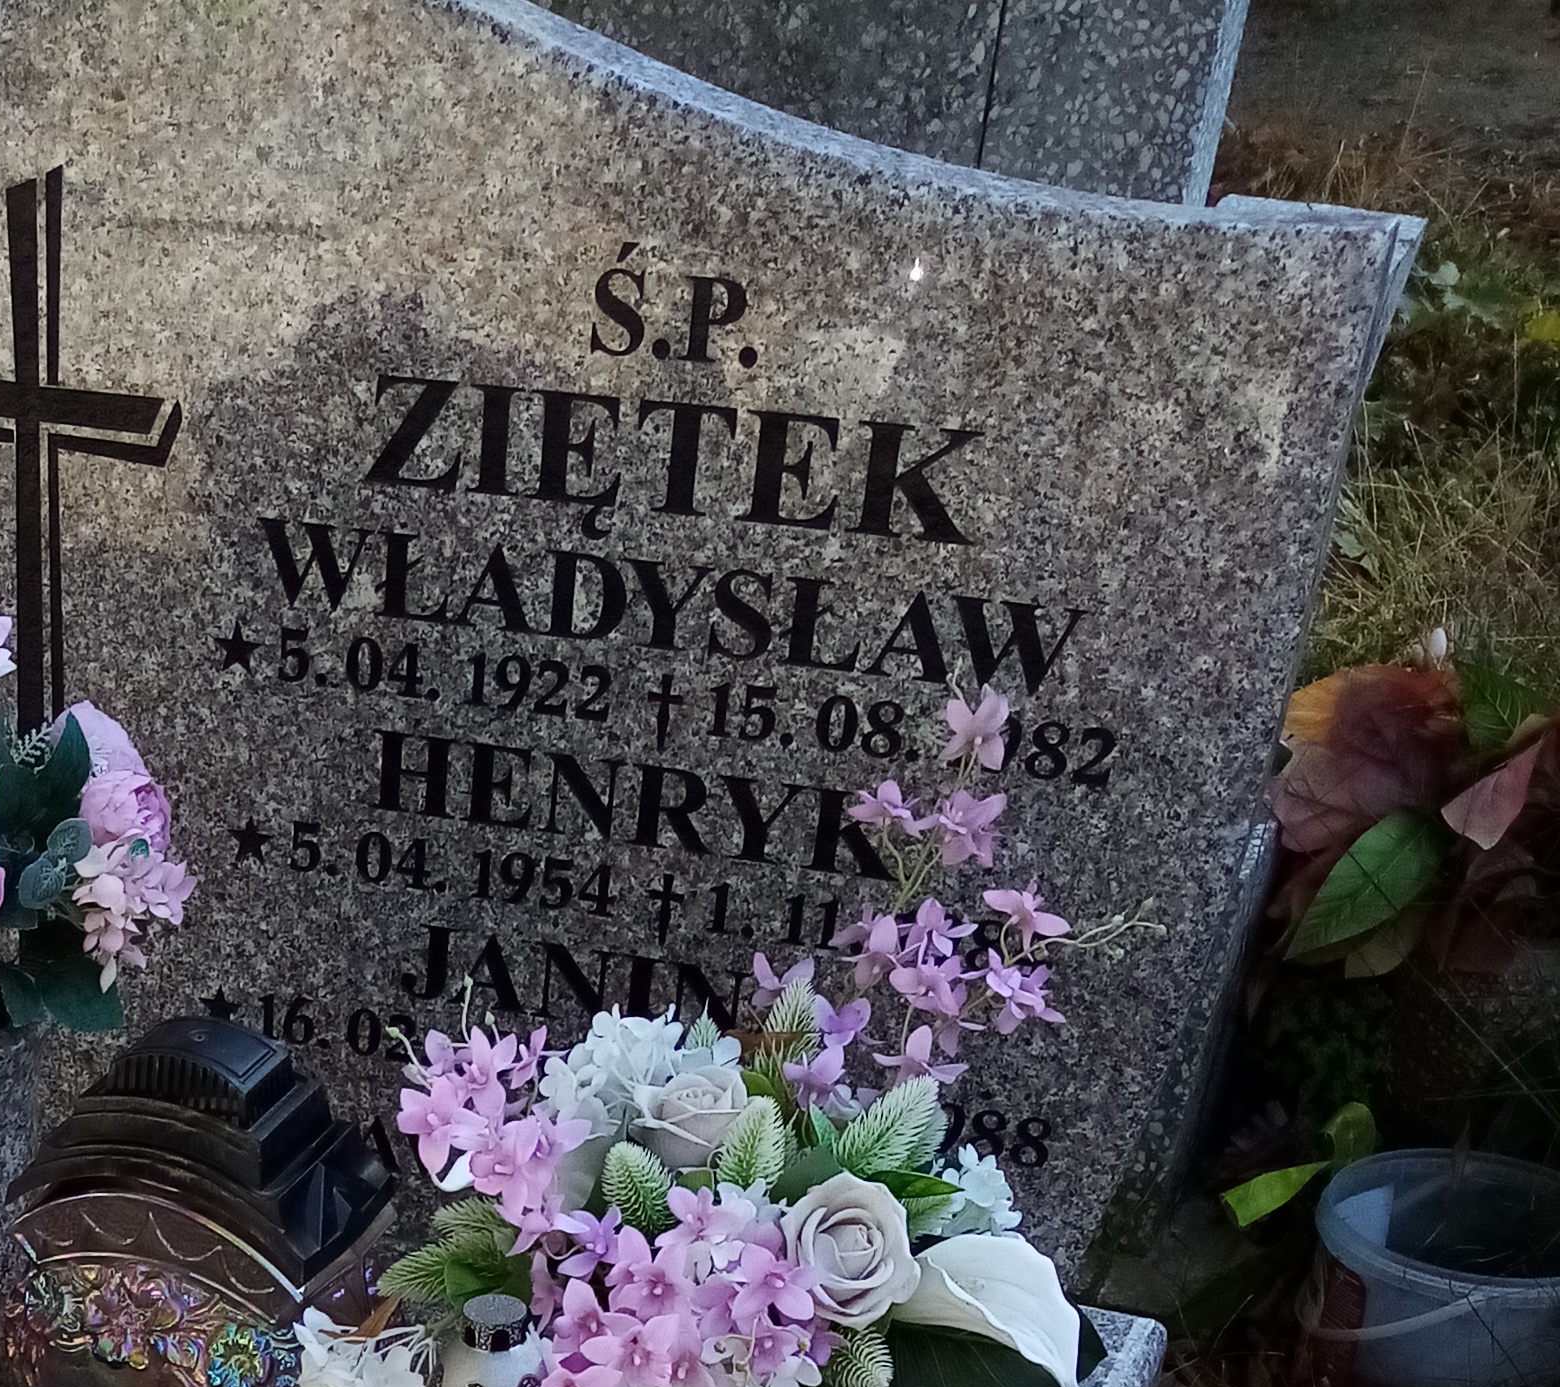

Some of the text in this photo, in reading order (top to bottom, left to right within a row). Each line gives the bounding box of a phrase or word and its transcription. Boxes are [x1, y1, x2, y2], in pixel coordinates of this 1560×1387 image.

[590, 242, 759, 370] Ś.P.
[365, 374, 985, 546] ZIĘTEK
[257, 516, 1087, 696] WŁADYSŁAW
[372, 728, 898, 883] HENRYK
[401, 924, 754, 1032] JANIN
